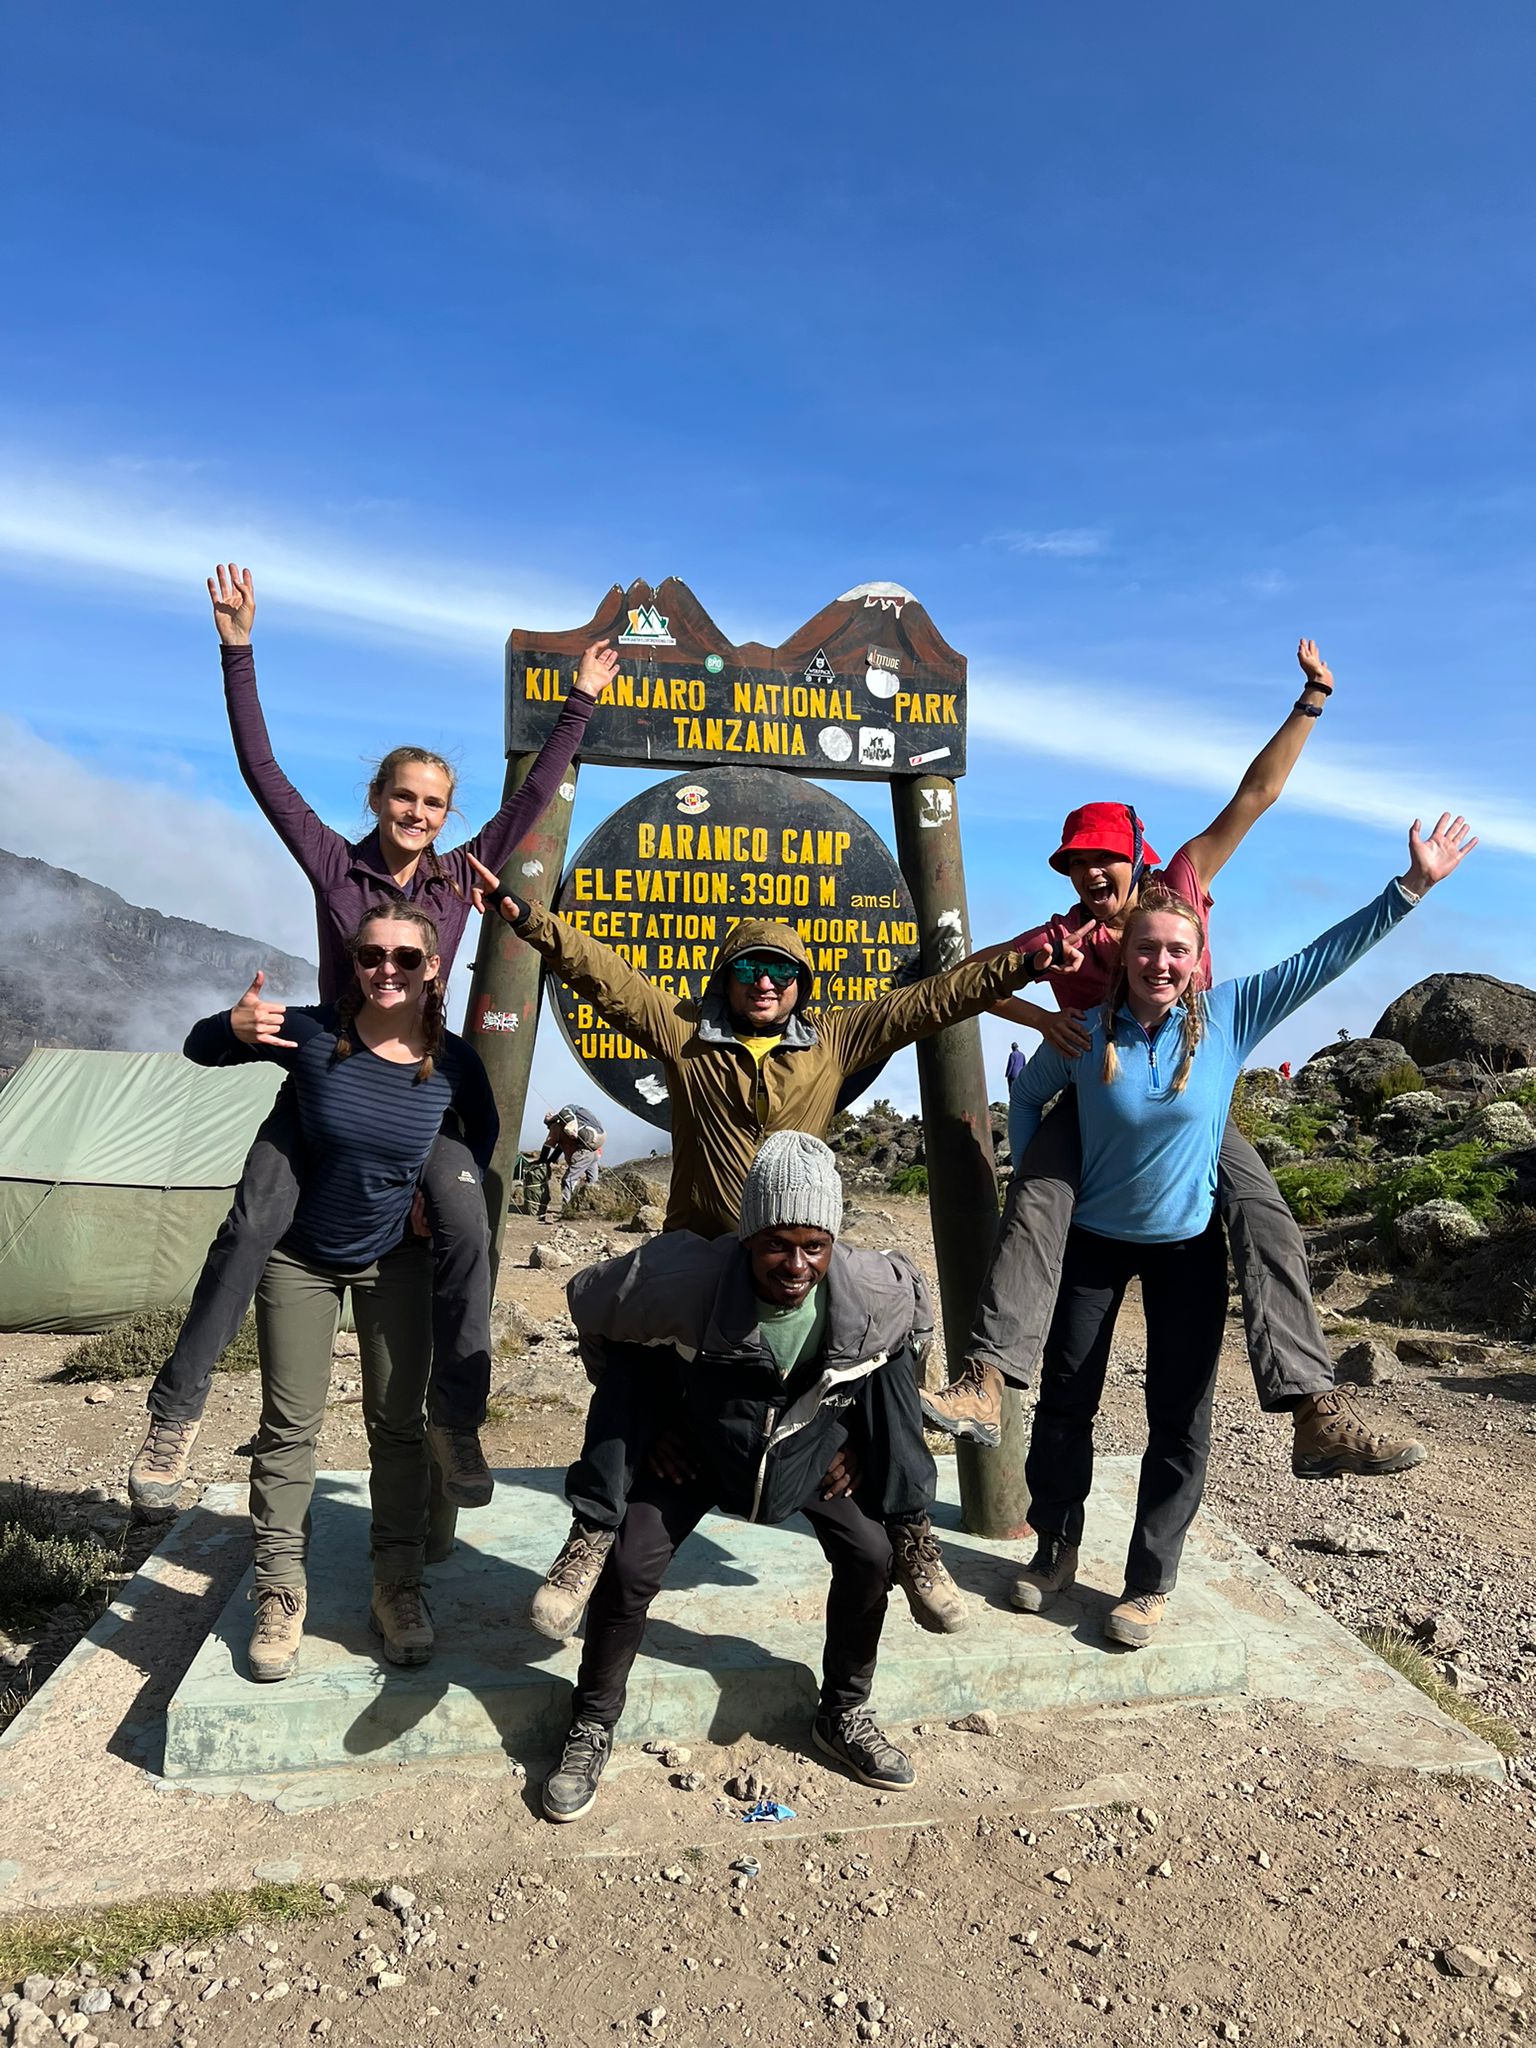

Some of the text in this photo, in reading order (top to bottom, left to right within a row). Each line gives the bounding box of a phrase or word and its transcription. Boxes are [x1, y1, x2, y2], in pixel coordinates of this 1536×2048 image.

[525, 667, 959, 725] KILANJARO NATIONAL PARK
[673, 716, 807, 756] TANZANIA
[638, 822, 851, 866] BARANCO CAMP
[819, 875, 836, 907] M
[850, 888, 901, 909] amsl
[797, 917, 918, 946] MOORLAND
